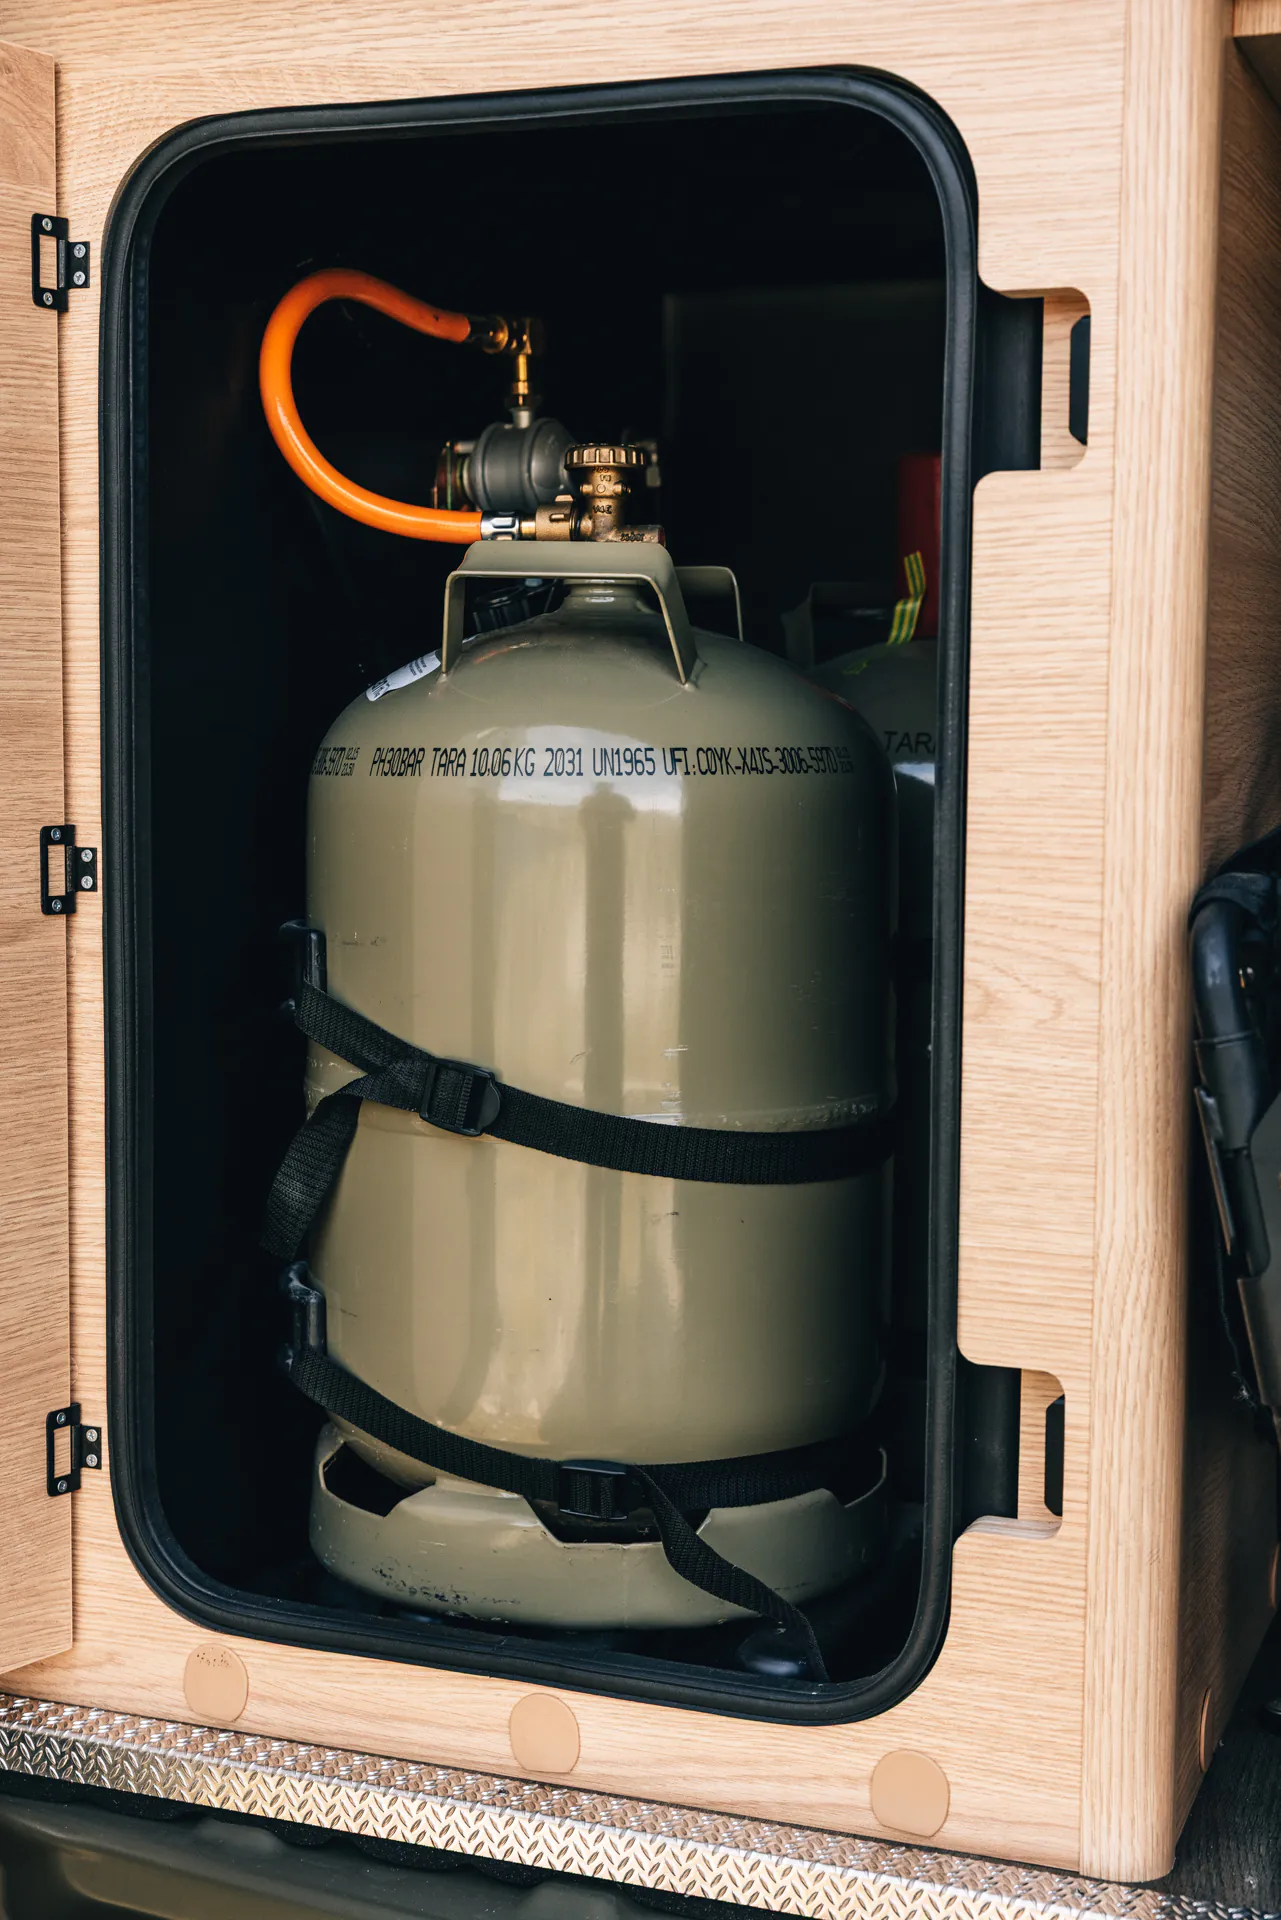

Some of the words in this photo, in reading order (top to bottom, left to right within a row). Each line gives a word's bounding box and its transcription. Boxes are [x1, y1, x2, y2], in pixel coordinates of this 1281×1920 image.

[369, 747, 426, 777] PH30BAR
[430, 747, 467, 777] TARA
[543, 747, 584, 777] 2031
[593, 747, 656, 777] UN1965
